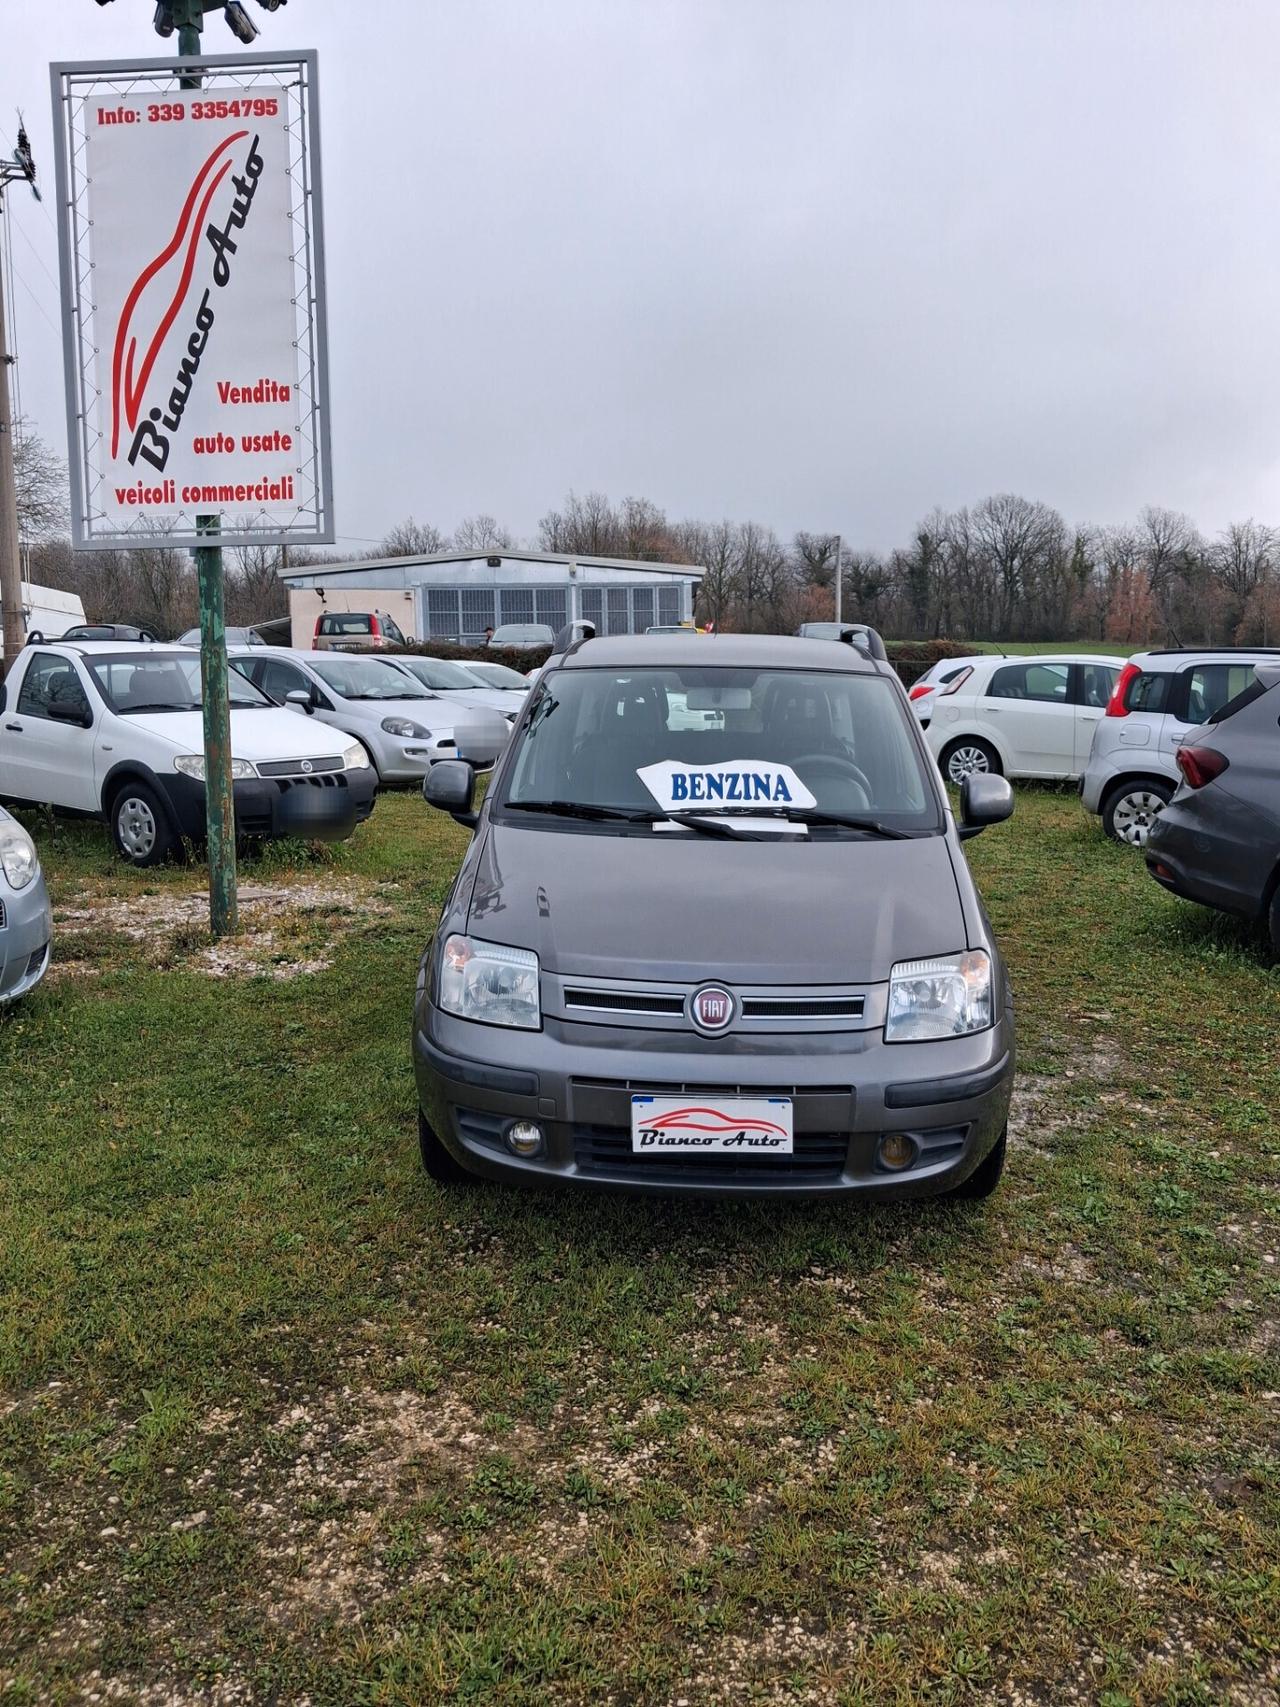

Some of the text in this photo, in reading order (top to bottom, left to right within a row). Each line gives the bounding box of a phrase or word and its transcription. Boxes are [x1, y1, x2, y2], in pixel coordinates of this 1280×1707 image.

[97, 99, 278, 125] Info: 339 3354795
[128, 134, 263, 473] Bianco Auto
[217, 379, 290, 404] Vendita
[193, 430, 292, 454] auto usate
[115, 476, 293, 505] veicoli commerciali
[671, 773, 793, 802] BENZINA
[702, 1000, 725, 1018] FIAT
[638, 1129, 788, 1147] Bianco Auto
